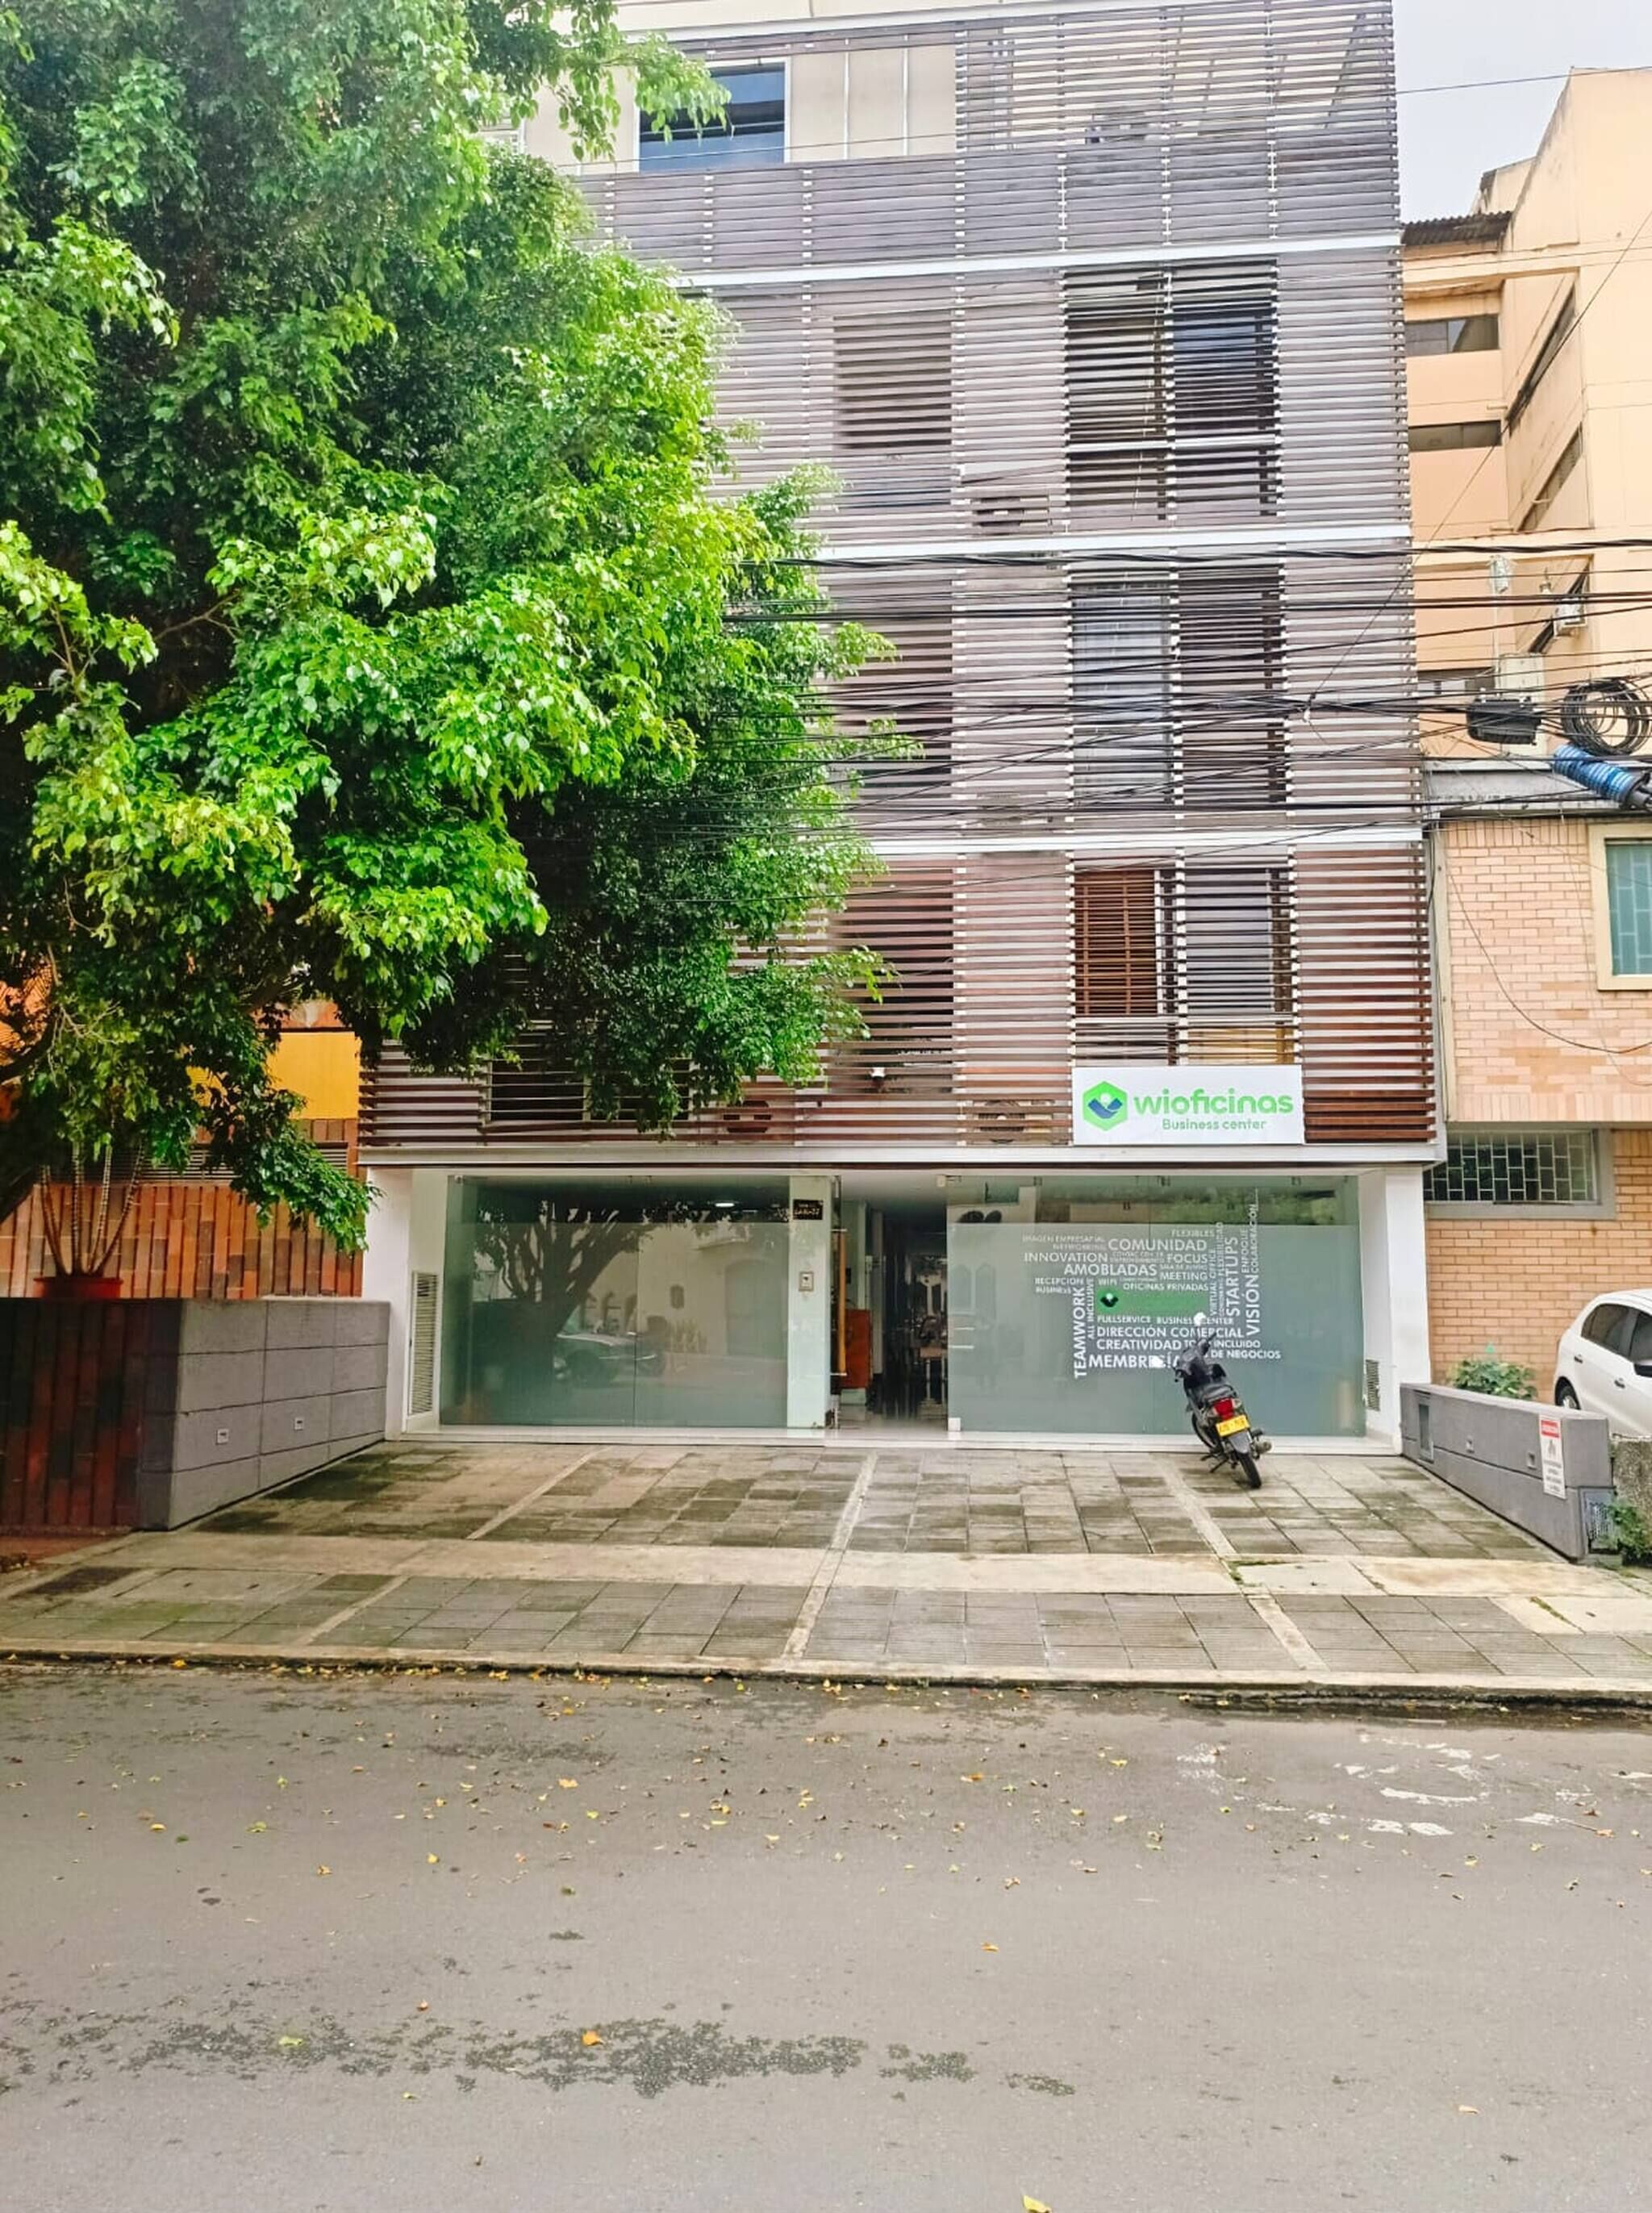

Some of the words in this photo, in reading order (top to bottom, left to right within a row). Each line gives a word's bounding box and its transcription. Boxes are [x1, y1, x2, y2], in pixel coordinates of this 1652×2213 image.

[1133, 1088, 1294, 1115] wioficinas
[1162, 1118, 1220, 1130] Business
[1222, 1119, 1267, 1130] center
[1108, 1238, 1208, 1251] COMUNIDAD
[1024, 1251, 1108, 1263] INNOVATION
[1166, 1254, 1208, 1263] FOCUS
[1064, 1263, 1158, 1276] AMOBLADAS
[1160, 1271, 1208, 1280] MEETING
[1224, 1237, 1240, 1317] STARTUPS
[1123, 1283, 1165, 1291] OFICINAS
[1167, 1283, 1209, 1291] PRIVADAS
[1241, 1275, 1260, 1336] VISIÓN
[1097, 1316, 1151, 1324] FULLSERVICE
[1157, 1316, 1199, 1325] BUSINES
[1073, 1286, 1087, 1379] TEAMWORK
[1096, 1325, 1167, 1338] DIRECCIÓN
[1096, 1339, 1182, 1351] CREATIVIDAD
[1214, 1340, 1261, 1349] INCLUIDO
[1211, 1351, 1224, 1359] DE
[1227, 1350, 1282, 1359] NEGOCIOS
